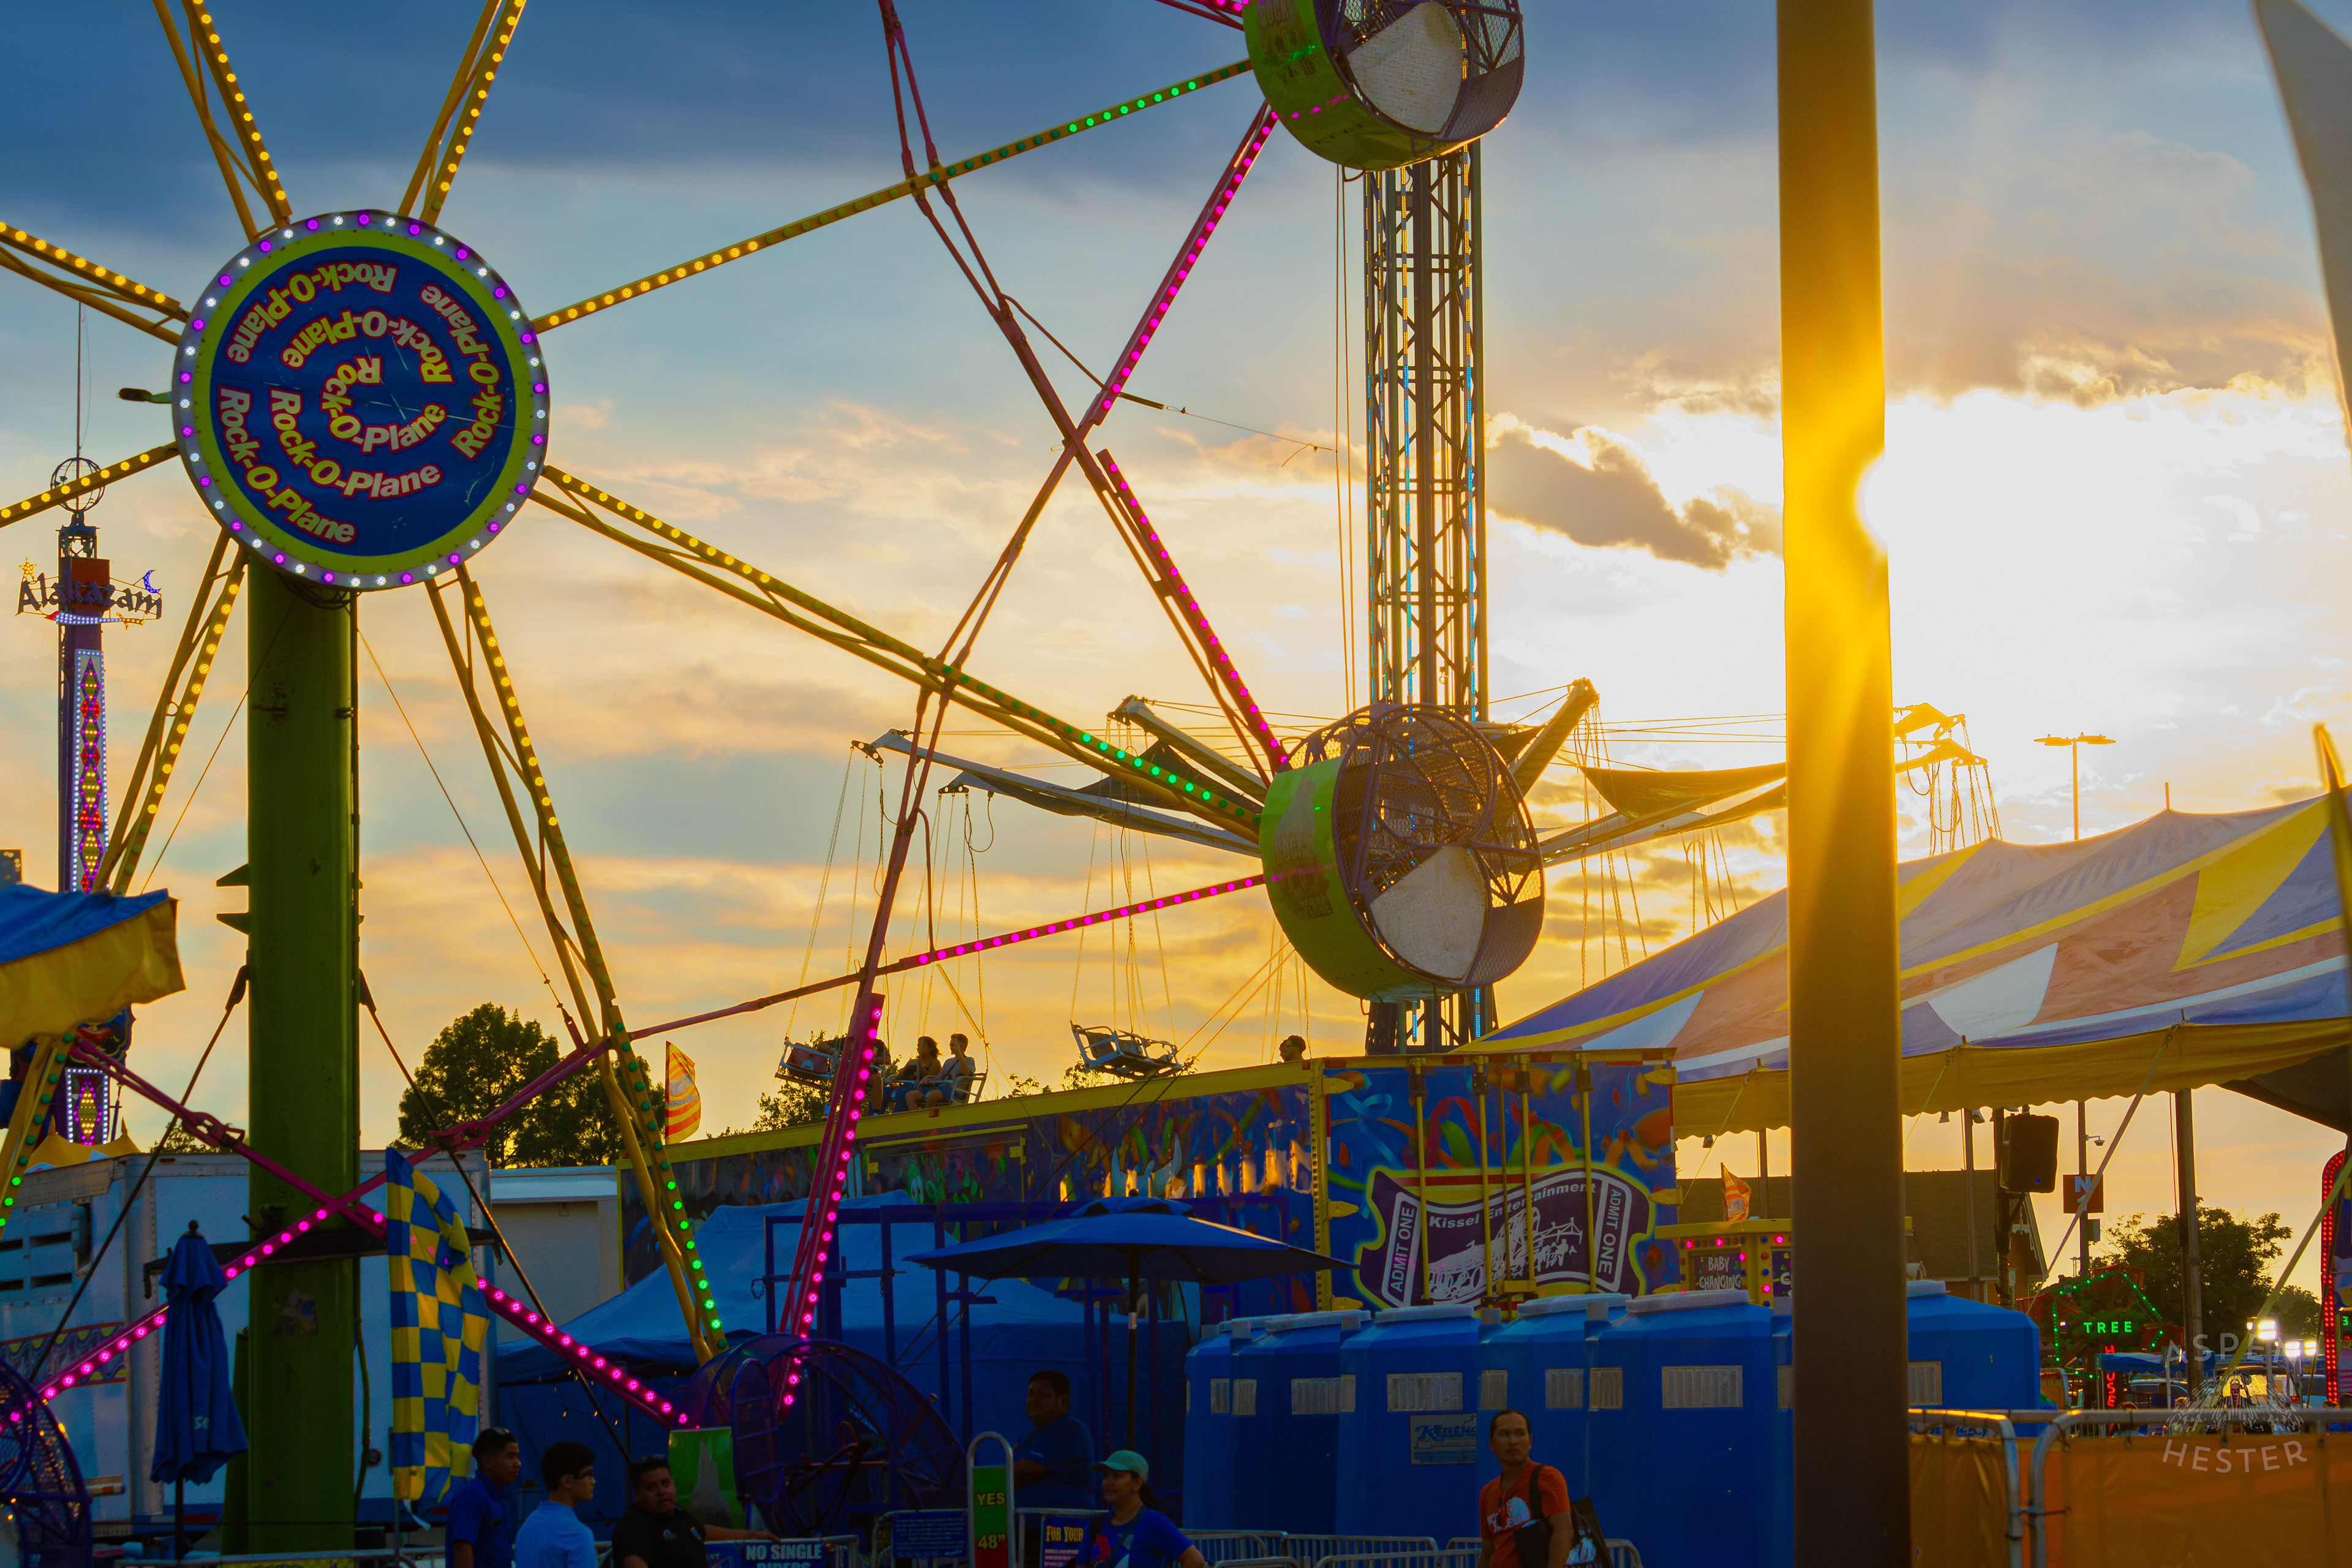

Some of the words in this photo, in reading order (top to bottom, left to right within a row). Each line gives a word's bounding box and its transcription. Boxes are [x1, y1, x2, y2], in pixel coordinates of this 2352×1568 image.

[227, 263, 396, 363] Rock-O-Plane
[282, 310, 453, 382] Rock-O-Plane
[420, 285, 501, 458] Rock-O-Plane
[321, 356, 448, 452] Rock-O-Plane
[270, 389, 440, 497] Rock-O-Plane
[219, 388, 355, 543] Rock-O-Plane
[17, 570, 162, 619] Alakazam
[1429, 1213, 1480, 1229] Kissel
[1489, 1182, 1596, 1220] Enterainment
[2075, 1175, 2091, 1193] N
[1398, 1207, 1415, 1240] ONE
[1605, 1189, 1622, 1230] ADMIT
[1390, 1242, 1409, 1292] ADMIT
[1598, 1233, 1616, 1275] ONE
[1708, 1256, 1730, 1272] BABY
[1698, 1274, 1742, 1291] CHANGING
[2083, 1321, 2132, 1334] TREE
[2104, 1344, 2116, 1408] HUSE
[977, 1492, 1006, 1506] YES
[745, 1545, 767, 1561] NO
[771, 1544, 823, 1560] SINGLE
[1046, 1525, 1062, 1543] FOR
